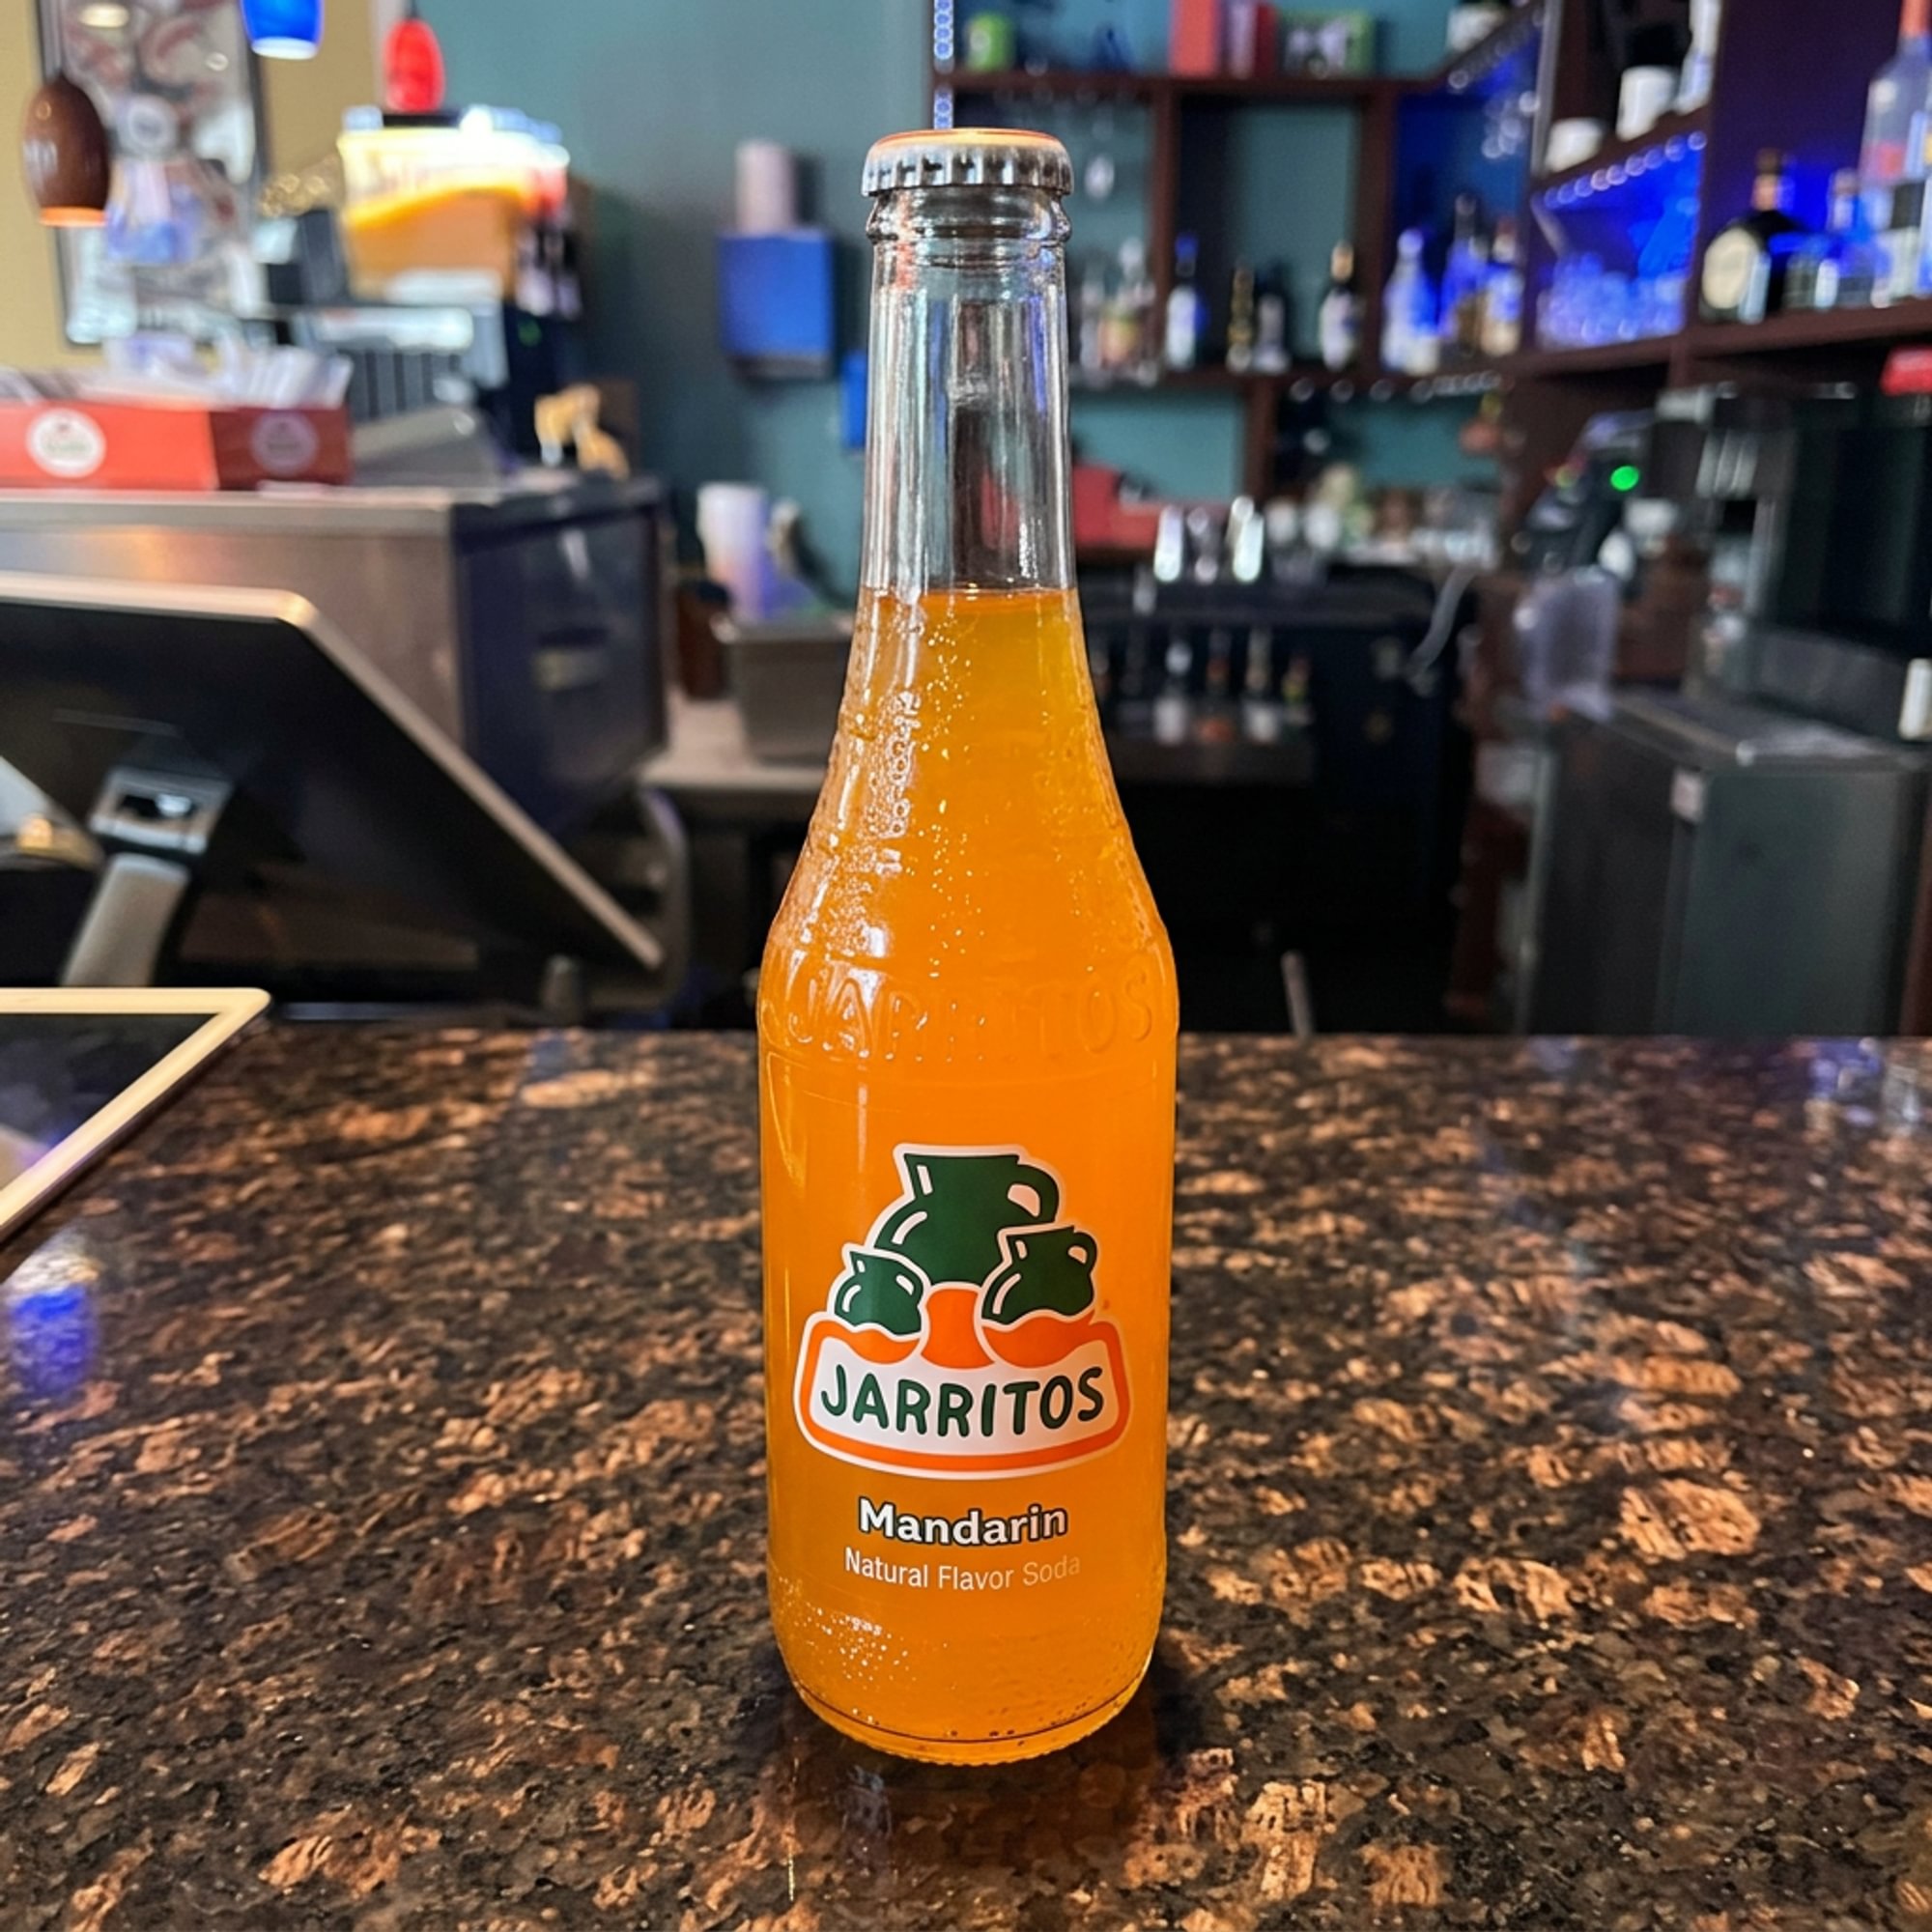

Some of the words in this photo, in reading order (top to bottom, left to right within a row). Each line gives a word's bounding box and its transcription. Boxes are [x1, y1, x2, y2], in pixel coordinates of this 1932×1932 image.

[787, 957, 1152, 1061] JARTOS
[821, 1364, 1103, 1437] JARRITOS
[859, 1496, 1067, 1546] Mandarin
[844, 1547, 928, 1588] Natural
[938, 1565, 1013, 1591] Flavor
[1022, 1554, 1081, 1587] Soda
